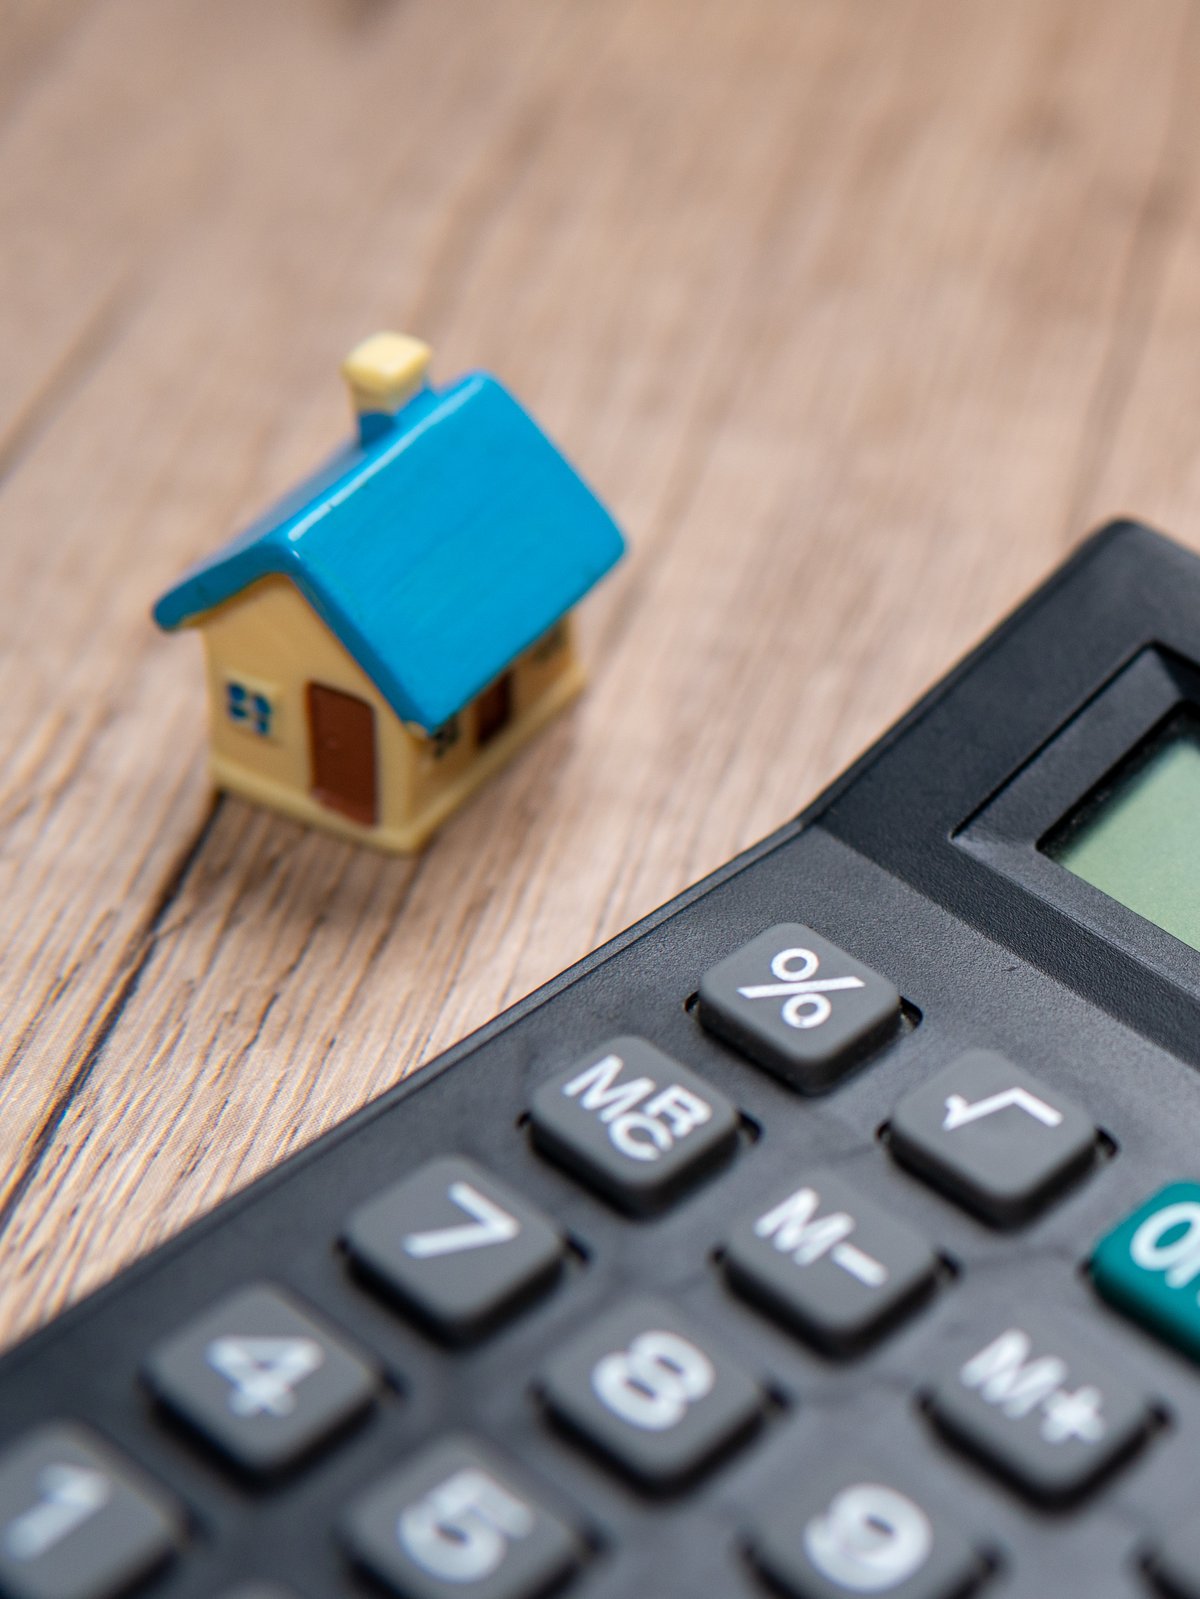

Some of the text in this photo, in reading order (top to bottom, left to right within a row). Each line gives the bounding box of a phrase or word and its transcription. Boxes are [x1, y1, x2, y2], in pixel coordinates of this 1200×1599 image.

[738, 947, 865, 1029] %
[404, 1183, 519, 1259] 7
[207, 1336, 323, 1416] 4
[592, 1331, 714, 1430] 8
[961, 1330, 1104, 1443] M+
[6, 1463, 108, 1561] 1
[400, 1468, 535, 1582] 5
[804, 1483, 932, 1592] 9
